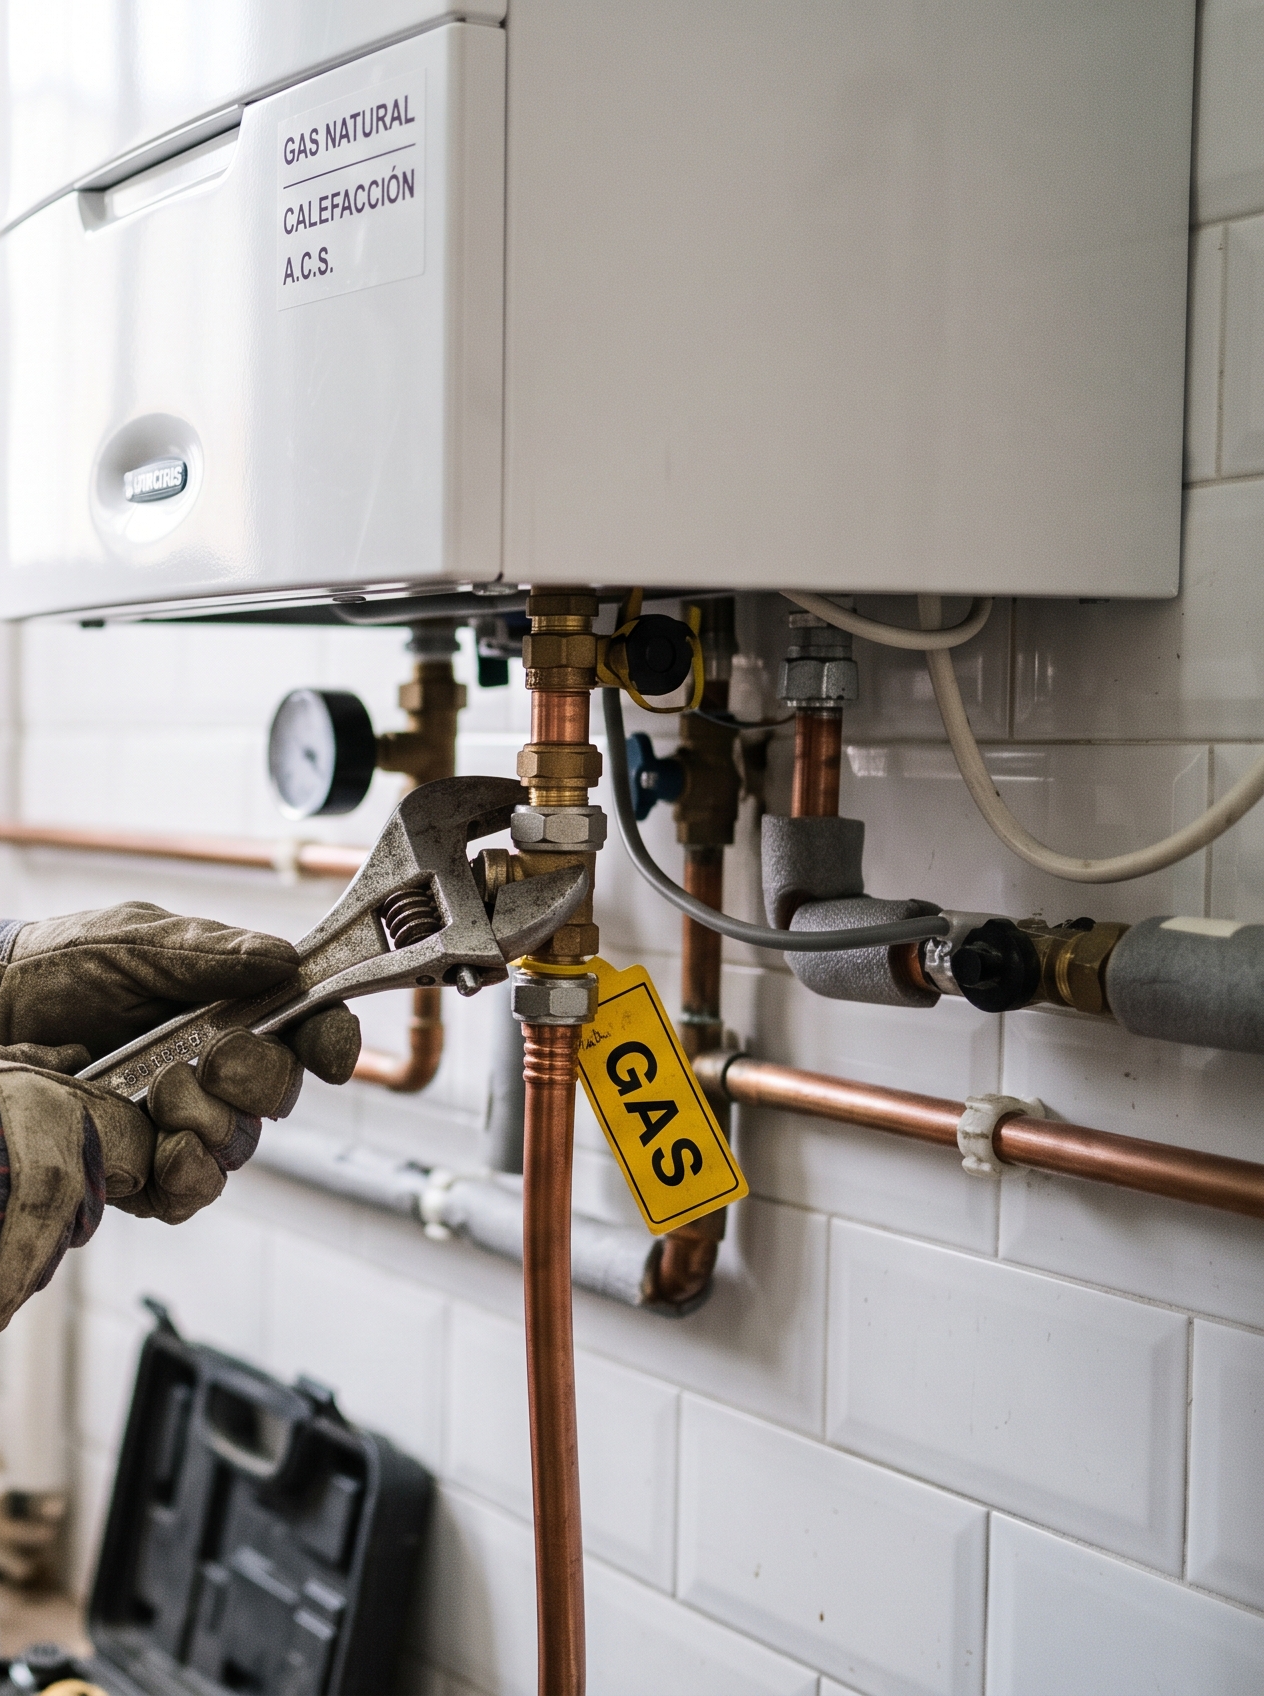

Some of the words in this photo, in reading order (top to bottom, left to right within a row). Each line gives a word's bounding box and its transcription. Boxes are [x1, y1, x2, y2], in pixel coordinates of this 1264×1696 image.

[283, 127, 320, 166] GAS
[325, 94, 416, 152] NATURAL
[283, 165, 415, 235] CALEFACCIÓN
[282, 246, 334, 286] A.C.S.
[605, 1040, 704, 1187] GAS
